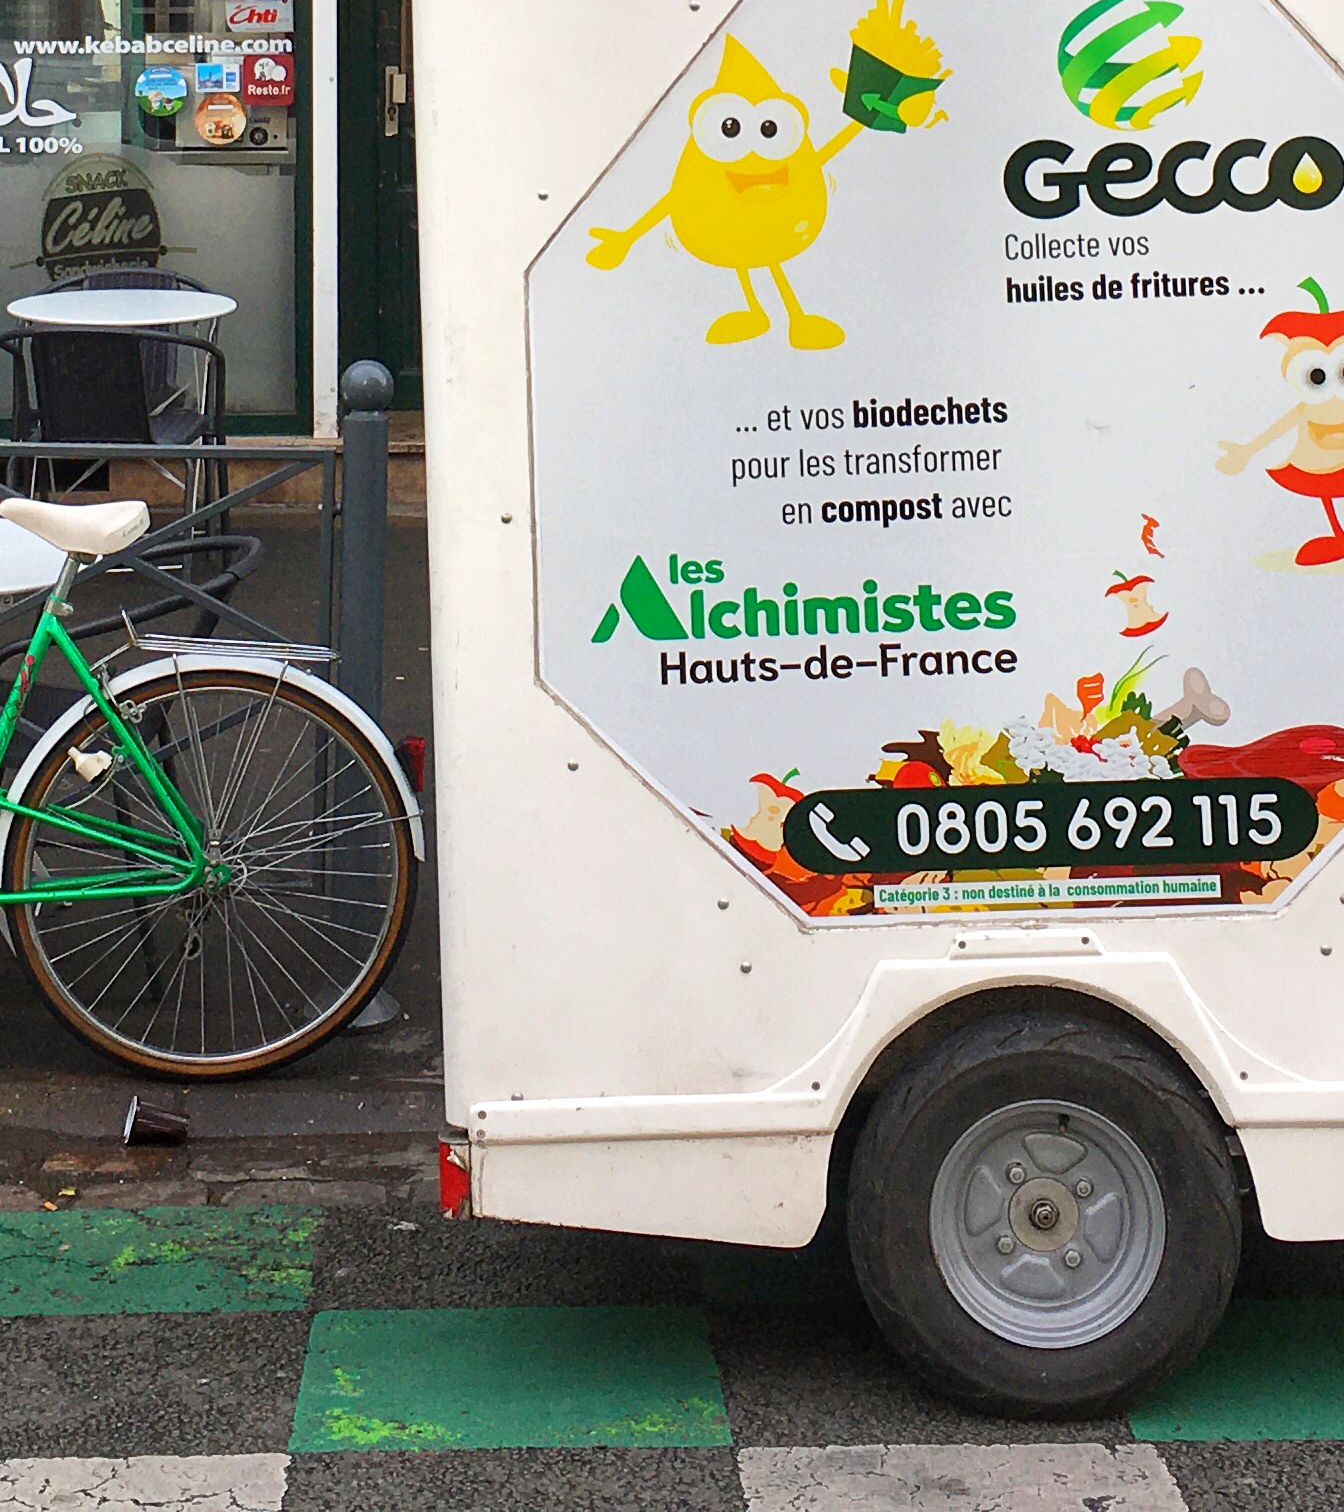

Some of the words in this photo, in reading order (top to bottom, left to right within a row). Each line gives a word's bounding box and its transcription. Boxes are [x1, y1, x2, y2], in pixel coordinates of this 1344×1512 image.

[14, 35, 293, 55] www.kebabceline.com
[15, 137, 83, 154] 100%
[66, 169, 128, 194] SNACK
[46, 196, 154, 254] Céline
[1005, 233, 1100, 261] Collecte
[1108, 236, 1150, 257] vos
[1006, 274, 1084, 304] huiles
[1084, 273, 1123, 300] de
[1131, 271, 1230, 299] fritures
[767, 405, 792, 431] et
[800, 408, 845, 430] vos
[853, 396, 1009, 428] biodechets
[732, 456, 790, 487] pour
[799, 449, 836, 477] les
[844, 444, 1002, 476] transformer
[782, 502, 812, 525] en
[821, 493, 943, 528] compost
[952, 495, 1012, 519] avec
[669, 553, 725, 585] les
[660, 644, 1019, 685] Hauts-de-France
[897, 799, 1048, 856] 0805
[1067, 794, 1174, 851] 692
[1193, 792, 1283, 846] 115
[879, 887, 940, 905] Catégorie
[943, 888, 951, 900] 3
[962, 888, 985, 900] non
[988, 884, 1035, 899] destiné
[1038, 884, 1046, 898] à
[1049, 884, 1060, 897] la
[1067, 880, 1160, 896] consommation
[1162, 878, 1217, 894] humaine
